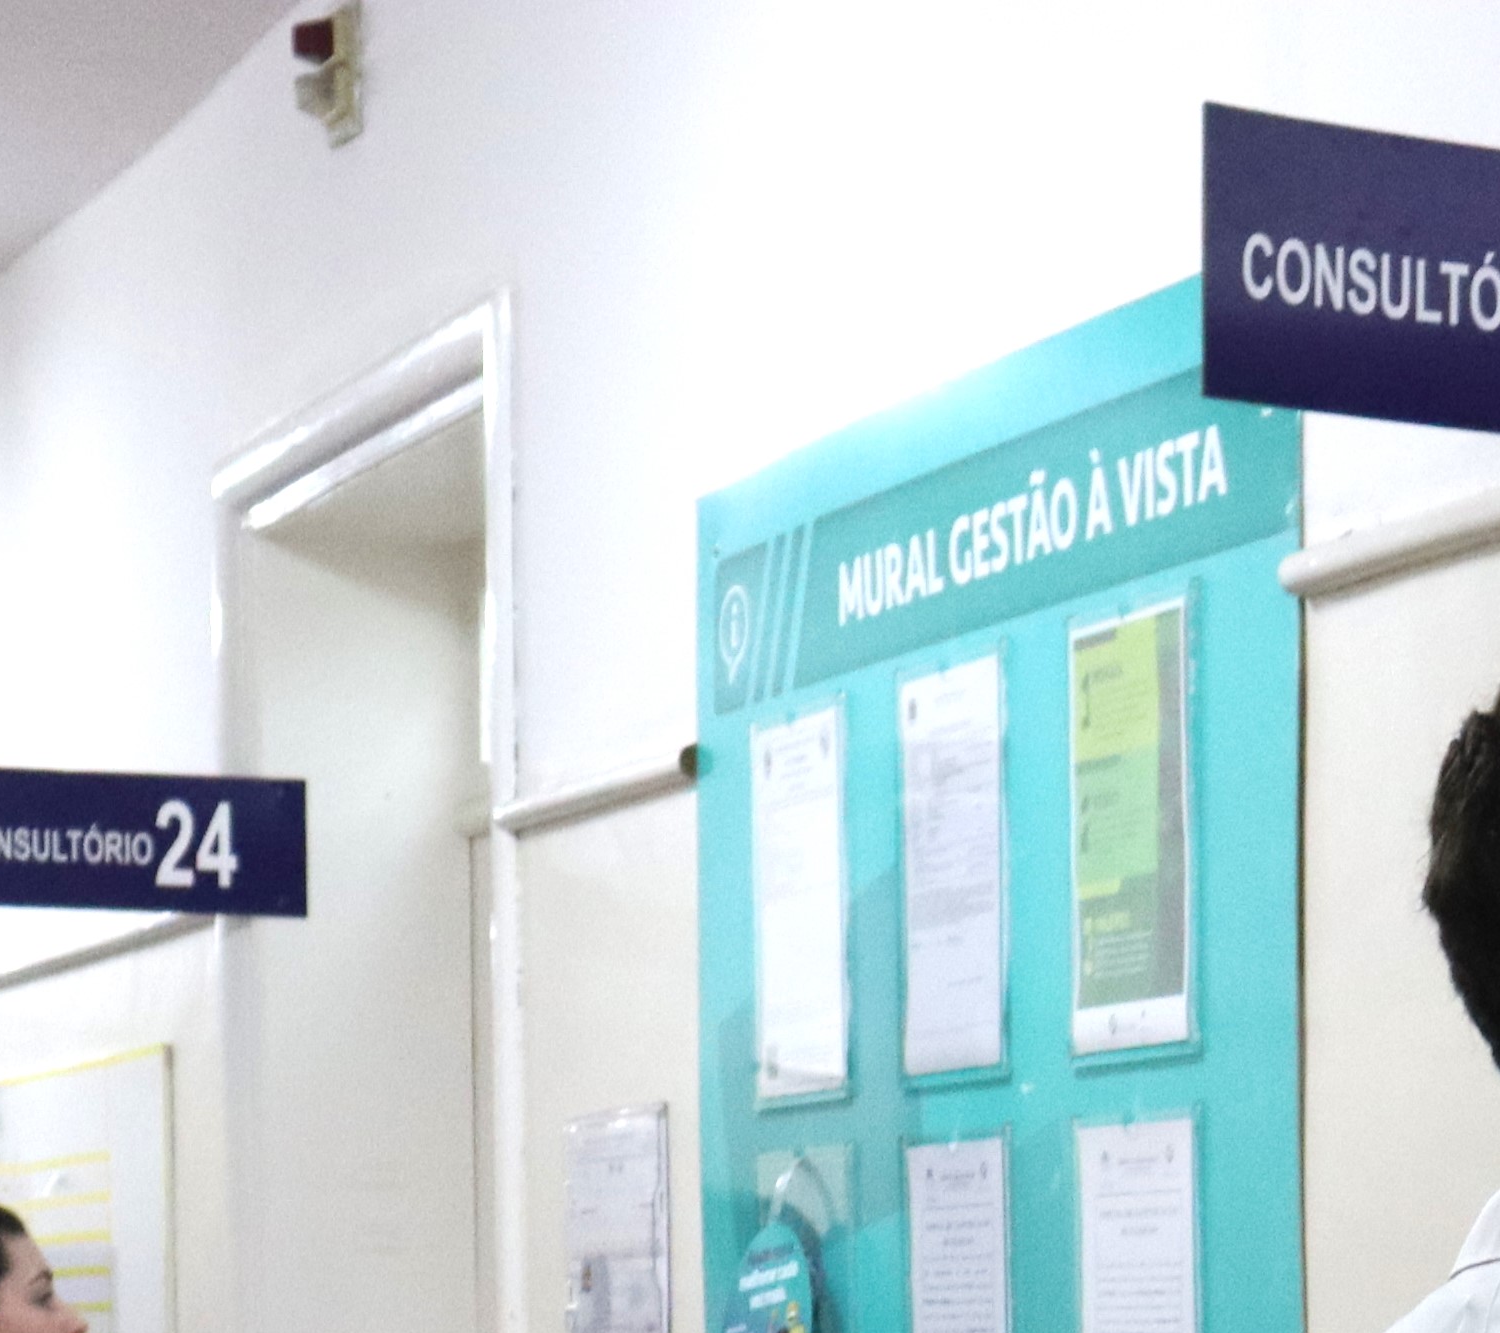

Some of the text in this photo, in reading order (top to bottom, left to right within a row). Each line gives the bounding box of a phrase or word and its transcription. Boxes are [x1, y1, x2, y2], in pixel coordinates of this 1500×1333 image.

[838, 423, 1228, 627] MURAL GESTÃO À VISTA
[155, 799, 239, 890] 24
